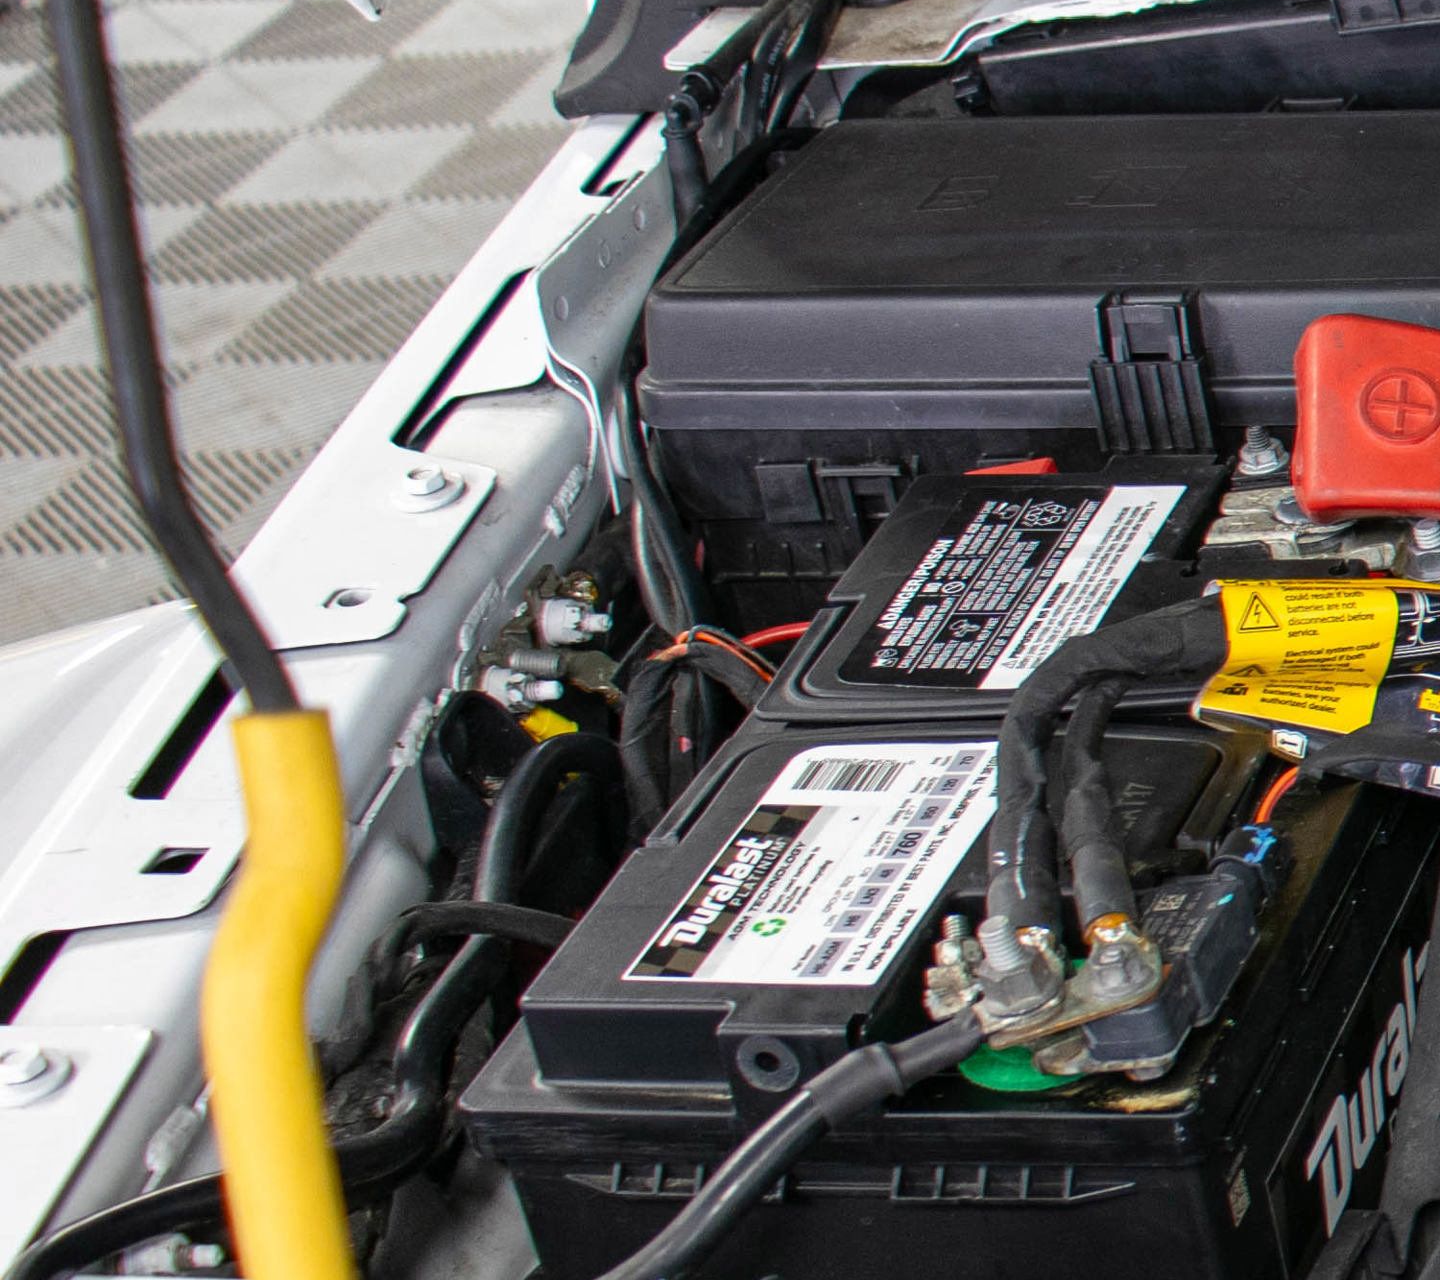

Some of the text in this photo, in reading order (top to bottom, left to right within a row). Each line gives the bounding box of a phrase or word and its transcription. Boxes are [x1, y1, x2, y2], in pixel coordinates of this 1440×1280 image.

[881, 539, 954, 620] DANGER/POISON
[939, 778, 960, 791] 120
[957, 755, 976, 765] 70
[727, 840, 789, 905] PLATINUM
[890, 832, 924, 855] 760
[657, 837, 778, 947] Duralast
[725, 841, 808, 940] AGM TECHNOLOGY
